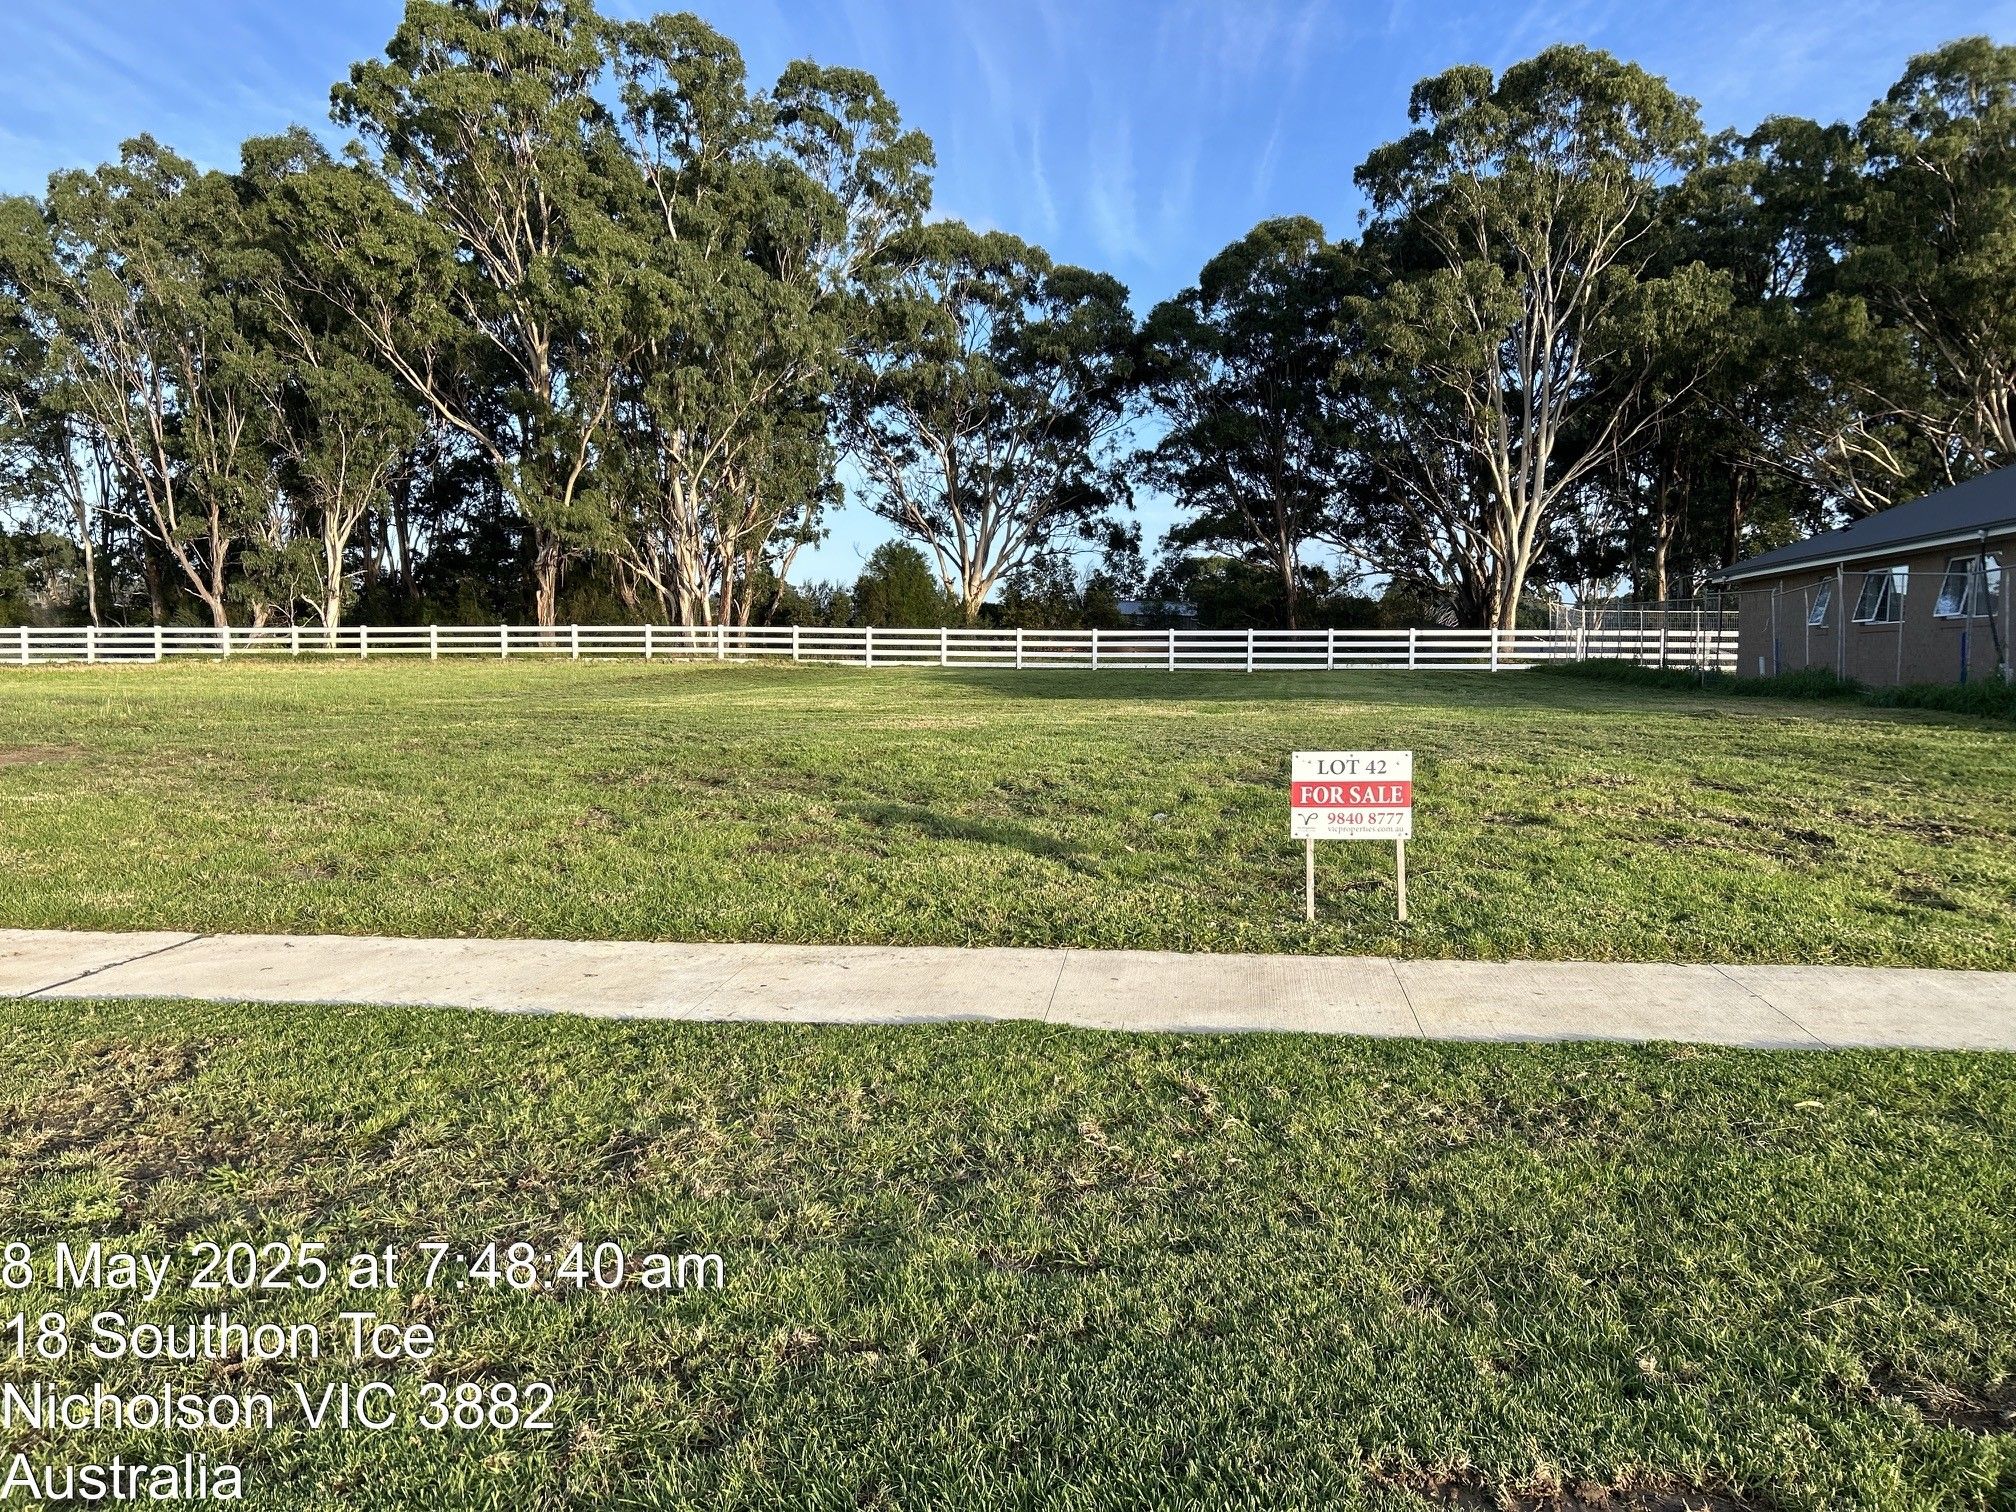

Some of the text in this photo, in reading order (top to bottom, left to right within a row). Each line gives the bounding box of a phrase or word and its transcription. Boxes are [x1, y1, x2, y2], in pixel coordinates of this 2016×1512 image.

[1318, 760, 1387, 775] LOT 42
[1300, 786, 1404, 804] FOR SALE
[1327, 812, 1404, 825] 9840 8777
